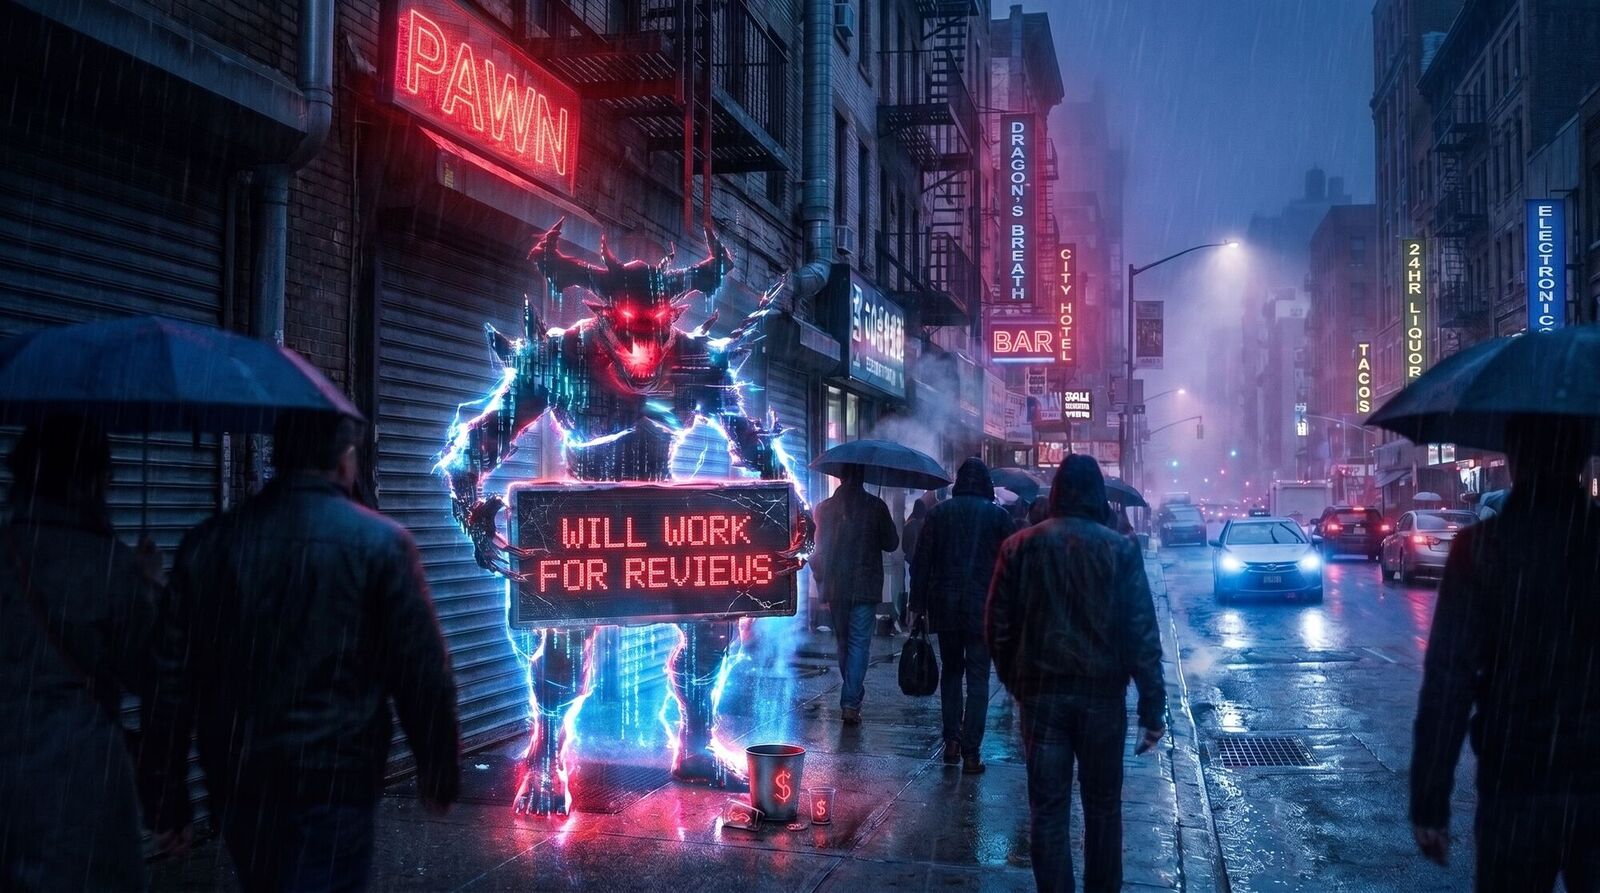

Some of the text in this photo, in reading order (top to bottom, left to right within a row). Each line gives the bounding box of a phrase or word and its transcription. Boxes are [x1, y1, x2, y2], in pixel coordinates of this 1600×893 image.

[406, 9, 568, 176] PAWN
[1011, 121, 1025, 299] DRAGON'S BREATH
[1059, 249, 1073, 361] CITY HOTEL
[1408, 243, 1422, 378] 24HR LIQUOR
[993, 330, 1053, 353] BAR
[1358, 343, 1370, 412] TACOS
[562, 515, 752, 549] WILL WORK
[539, 554, 773, 592] FOR REVIEWS
[775, 770, 791, 802] $
[816, 798, 826, 816] $
